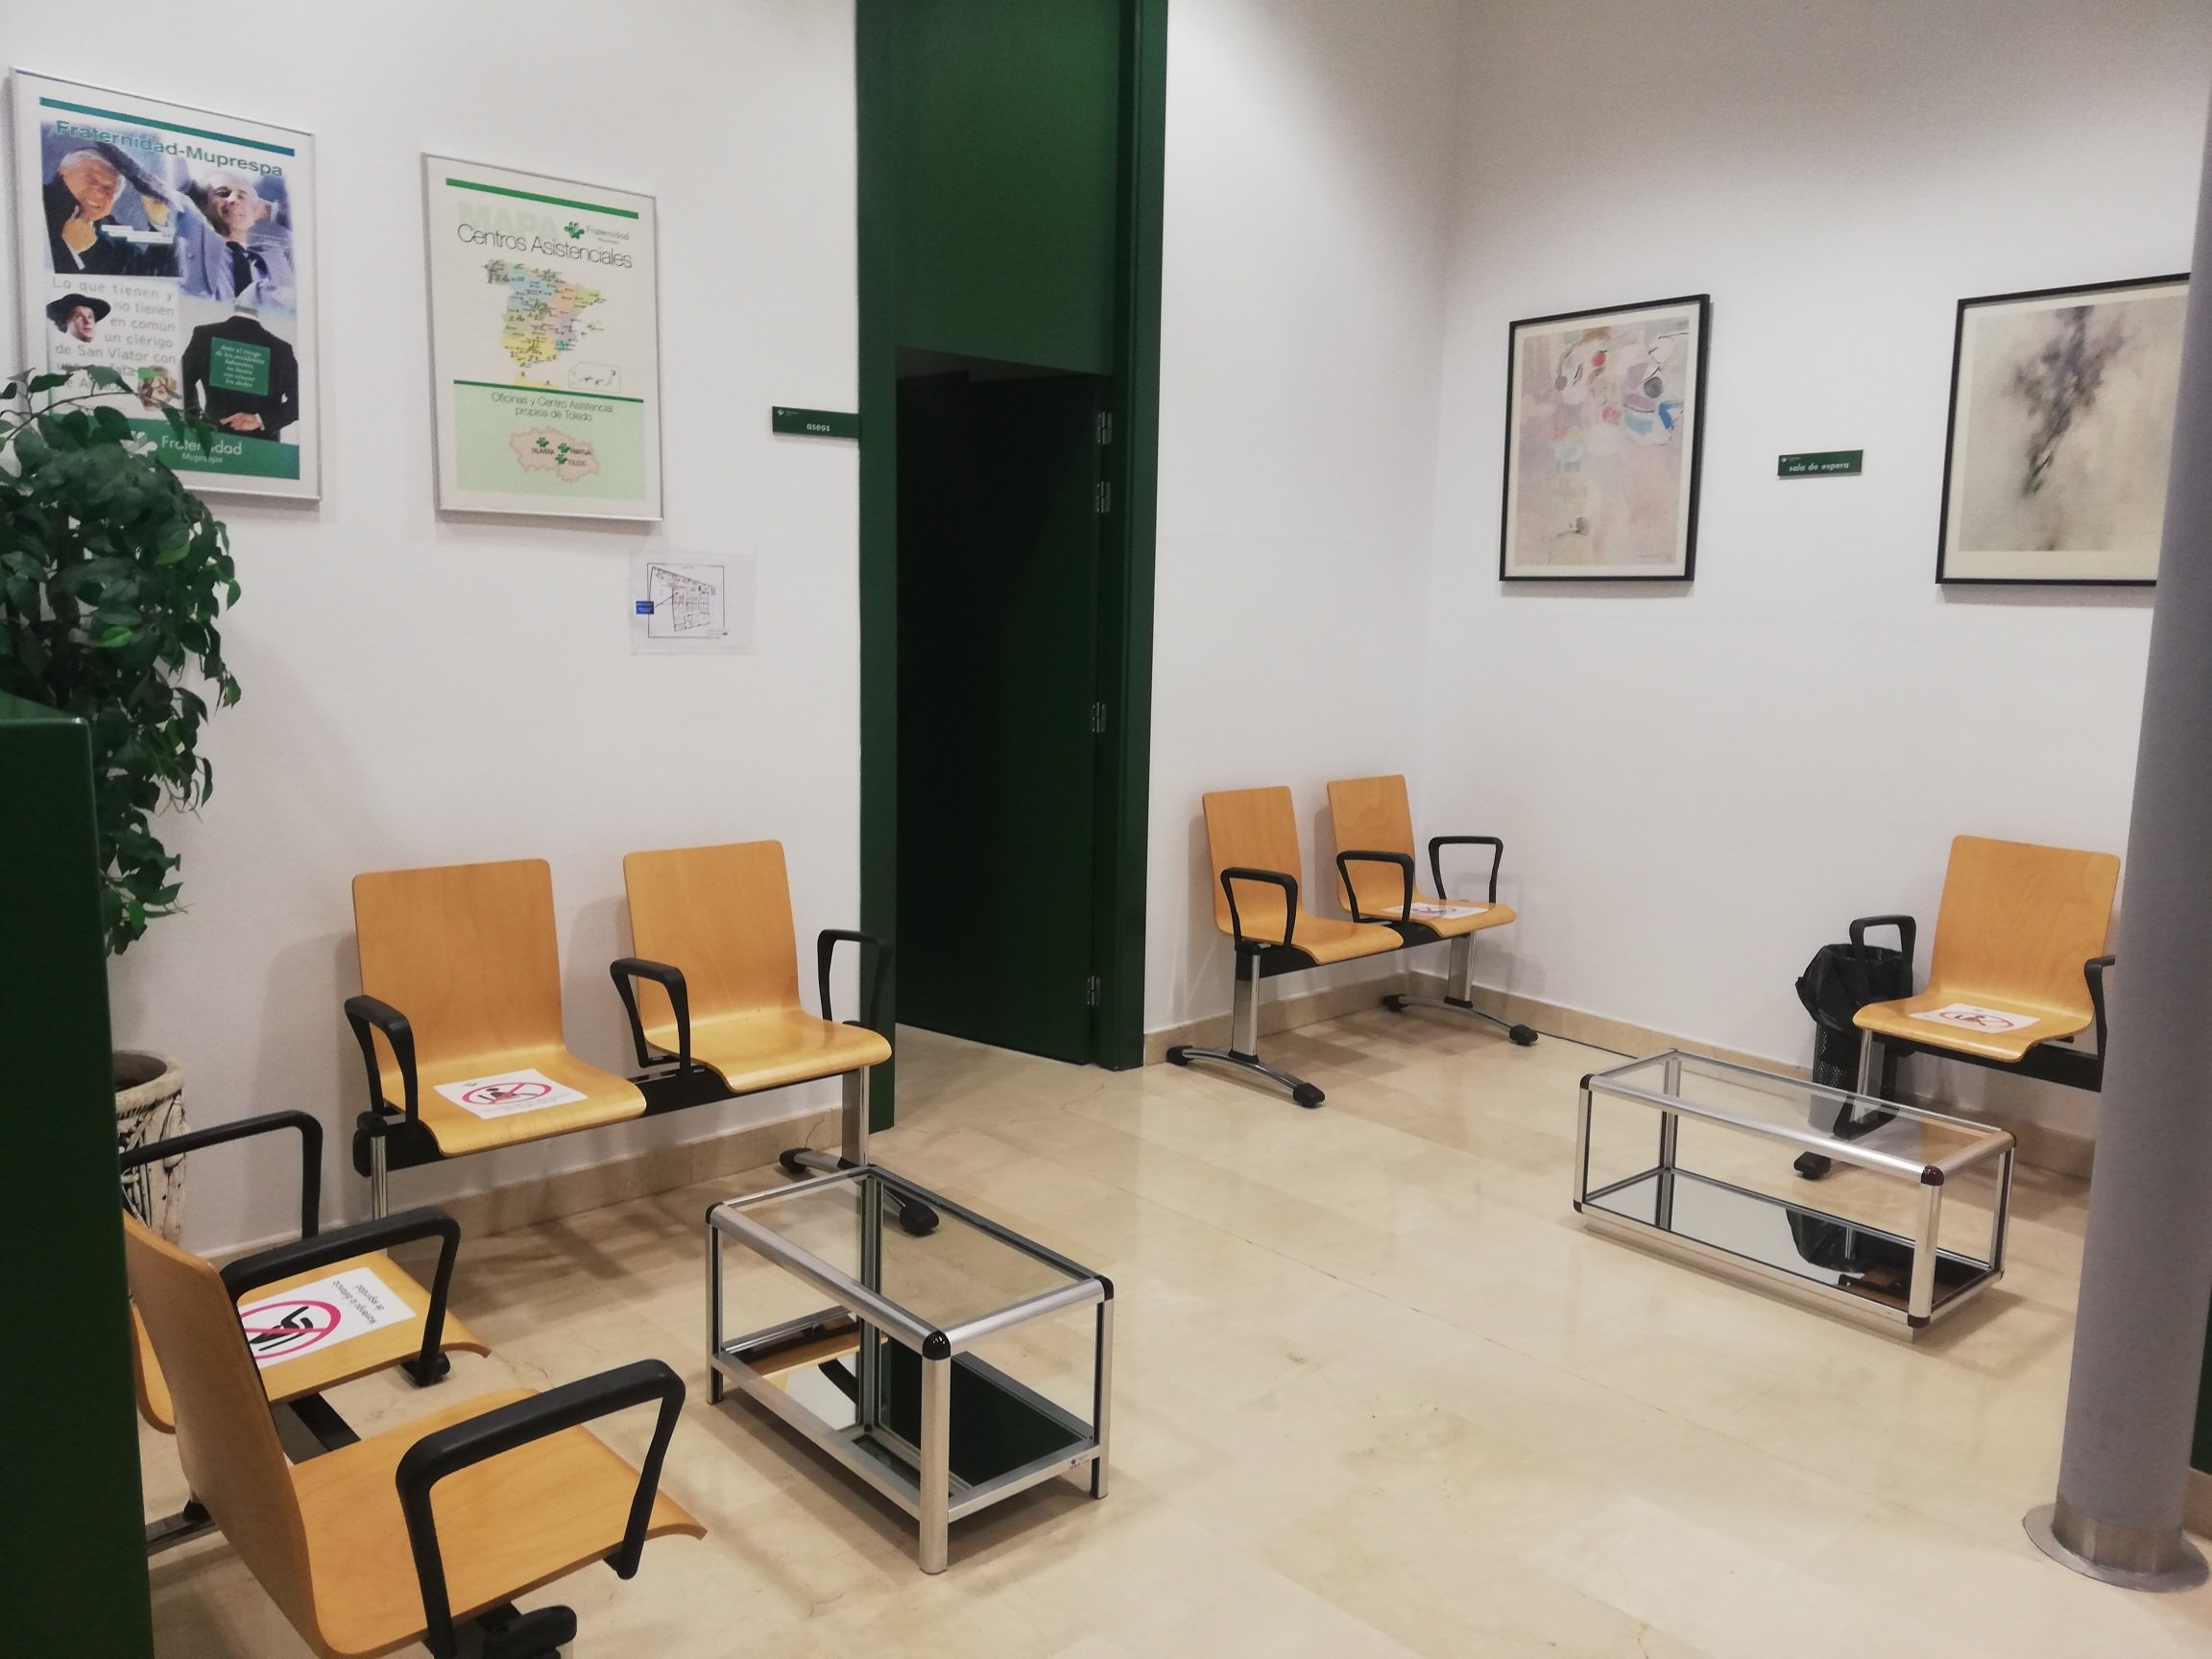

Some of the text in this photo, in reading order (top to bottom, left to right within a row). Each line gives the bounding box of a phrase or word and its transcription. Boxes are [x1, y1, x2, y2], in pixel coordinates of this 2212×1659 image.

[55, 119, 283, 178] Fraternidad-Muprespa
[457, 223, 633, 269] Centros Asistenciales
[52, 276, 173, 302] Lo que tienen y
[114, 301, 175, 316] no tienen
[109, 317, 176, 332] en común
[105, 333, 121, 343] un
[56, 343, 177, 364] de San Viator con
[492, 392, 527, 404] Oficinas
[538, 397, 567, 408] Centro
[550, 410, 562, 419] de
[565, 410, 592, 421] Toledo
[806, 423, 830, 432] aseos
[1789, 464, 1806, 472] sala
